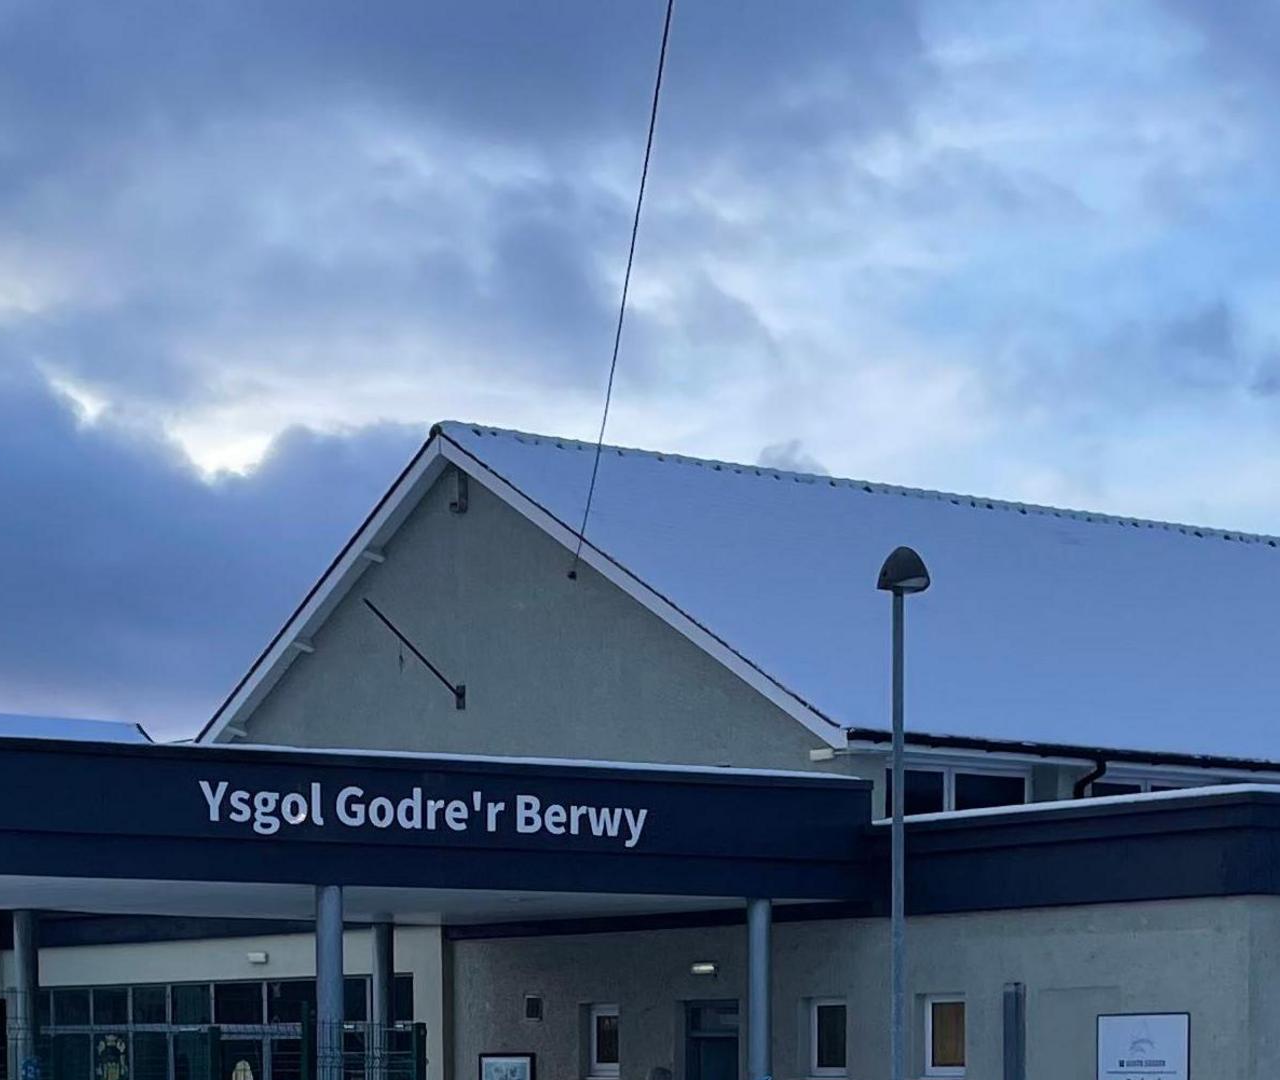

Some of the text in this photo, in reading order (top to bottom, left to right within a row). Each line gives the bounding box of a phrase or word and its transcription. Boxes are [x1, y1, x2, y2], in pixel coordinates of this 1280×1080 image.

[199, 781, 647, 847] Ysgol Godre'r Berwy
